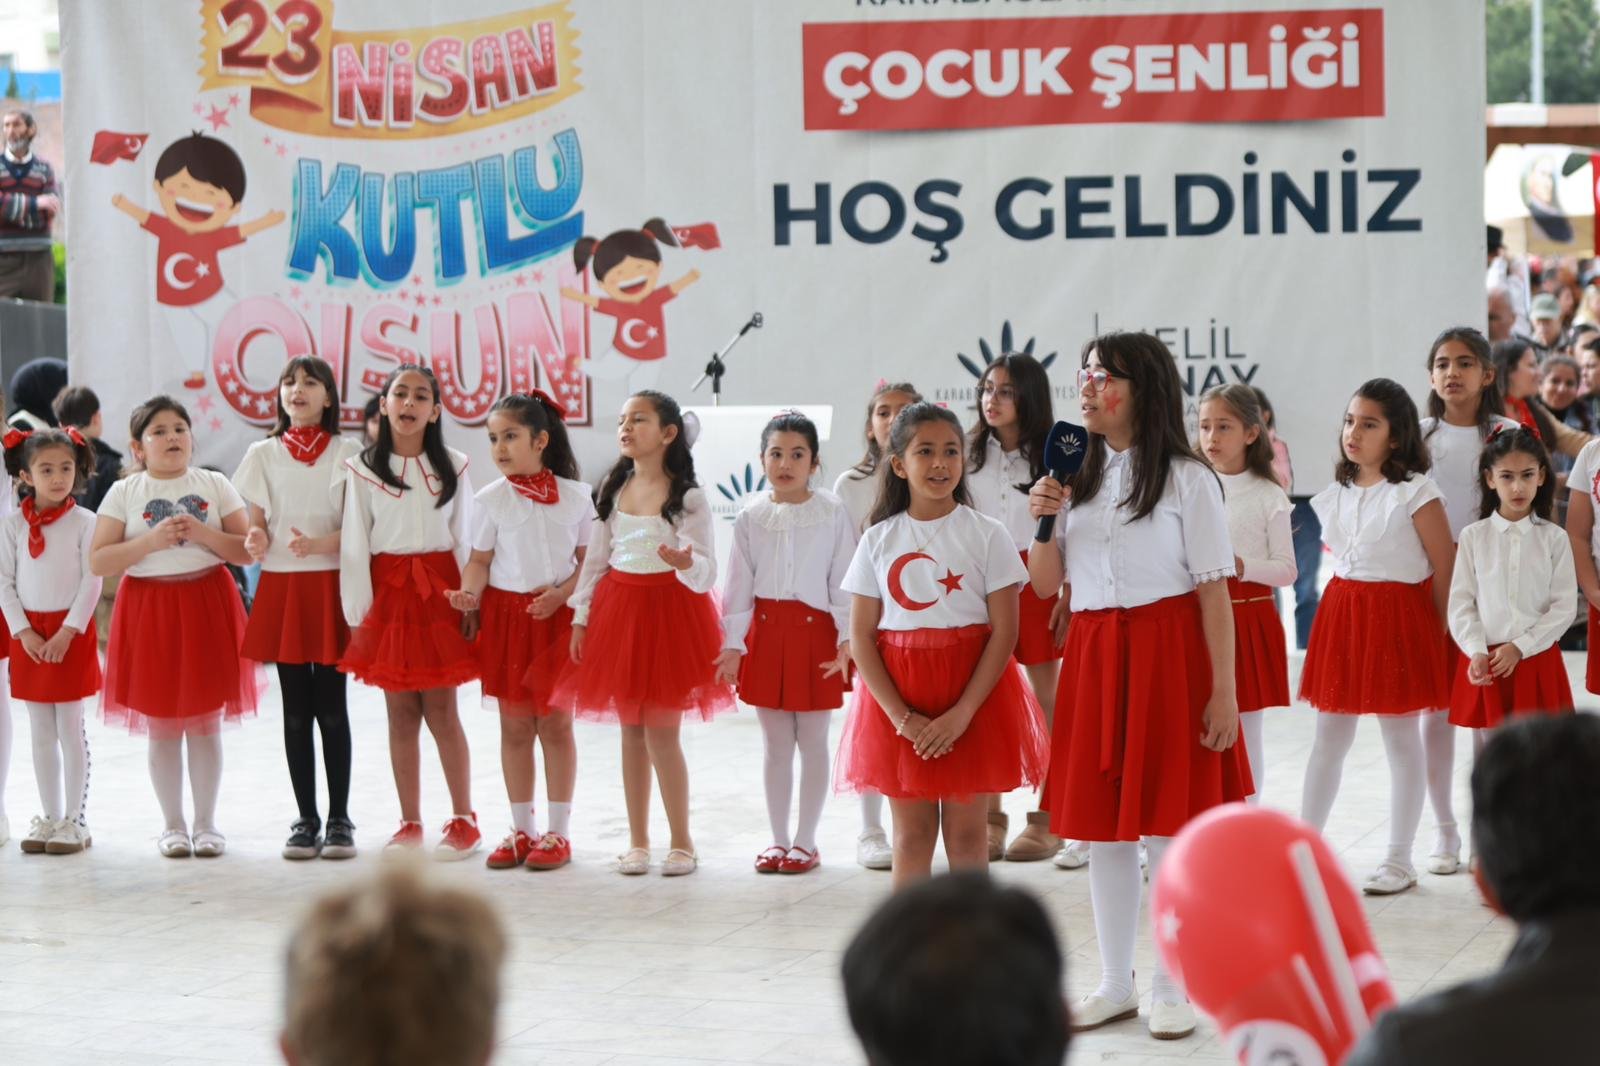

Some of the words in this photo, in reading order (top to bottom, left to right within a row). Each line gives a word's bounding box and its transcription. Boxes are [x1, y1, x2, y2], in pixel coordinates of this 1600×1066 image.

[216, 0, 326, 84] 23
[822, 47, 1073, 115] ÇOCUK
[1090, 23, 1361, 109] ŞENLİĞİ
[288, 128, 585, 288] KUTLU
[773, 180, 964, 264] HOŞ
[995, 149, 1422, 241] GELDİNİZ
